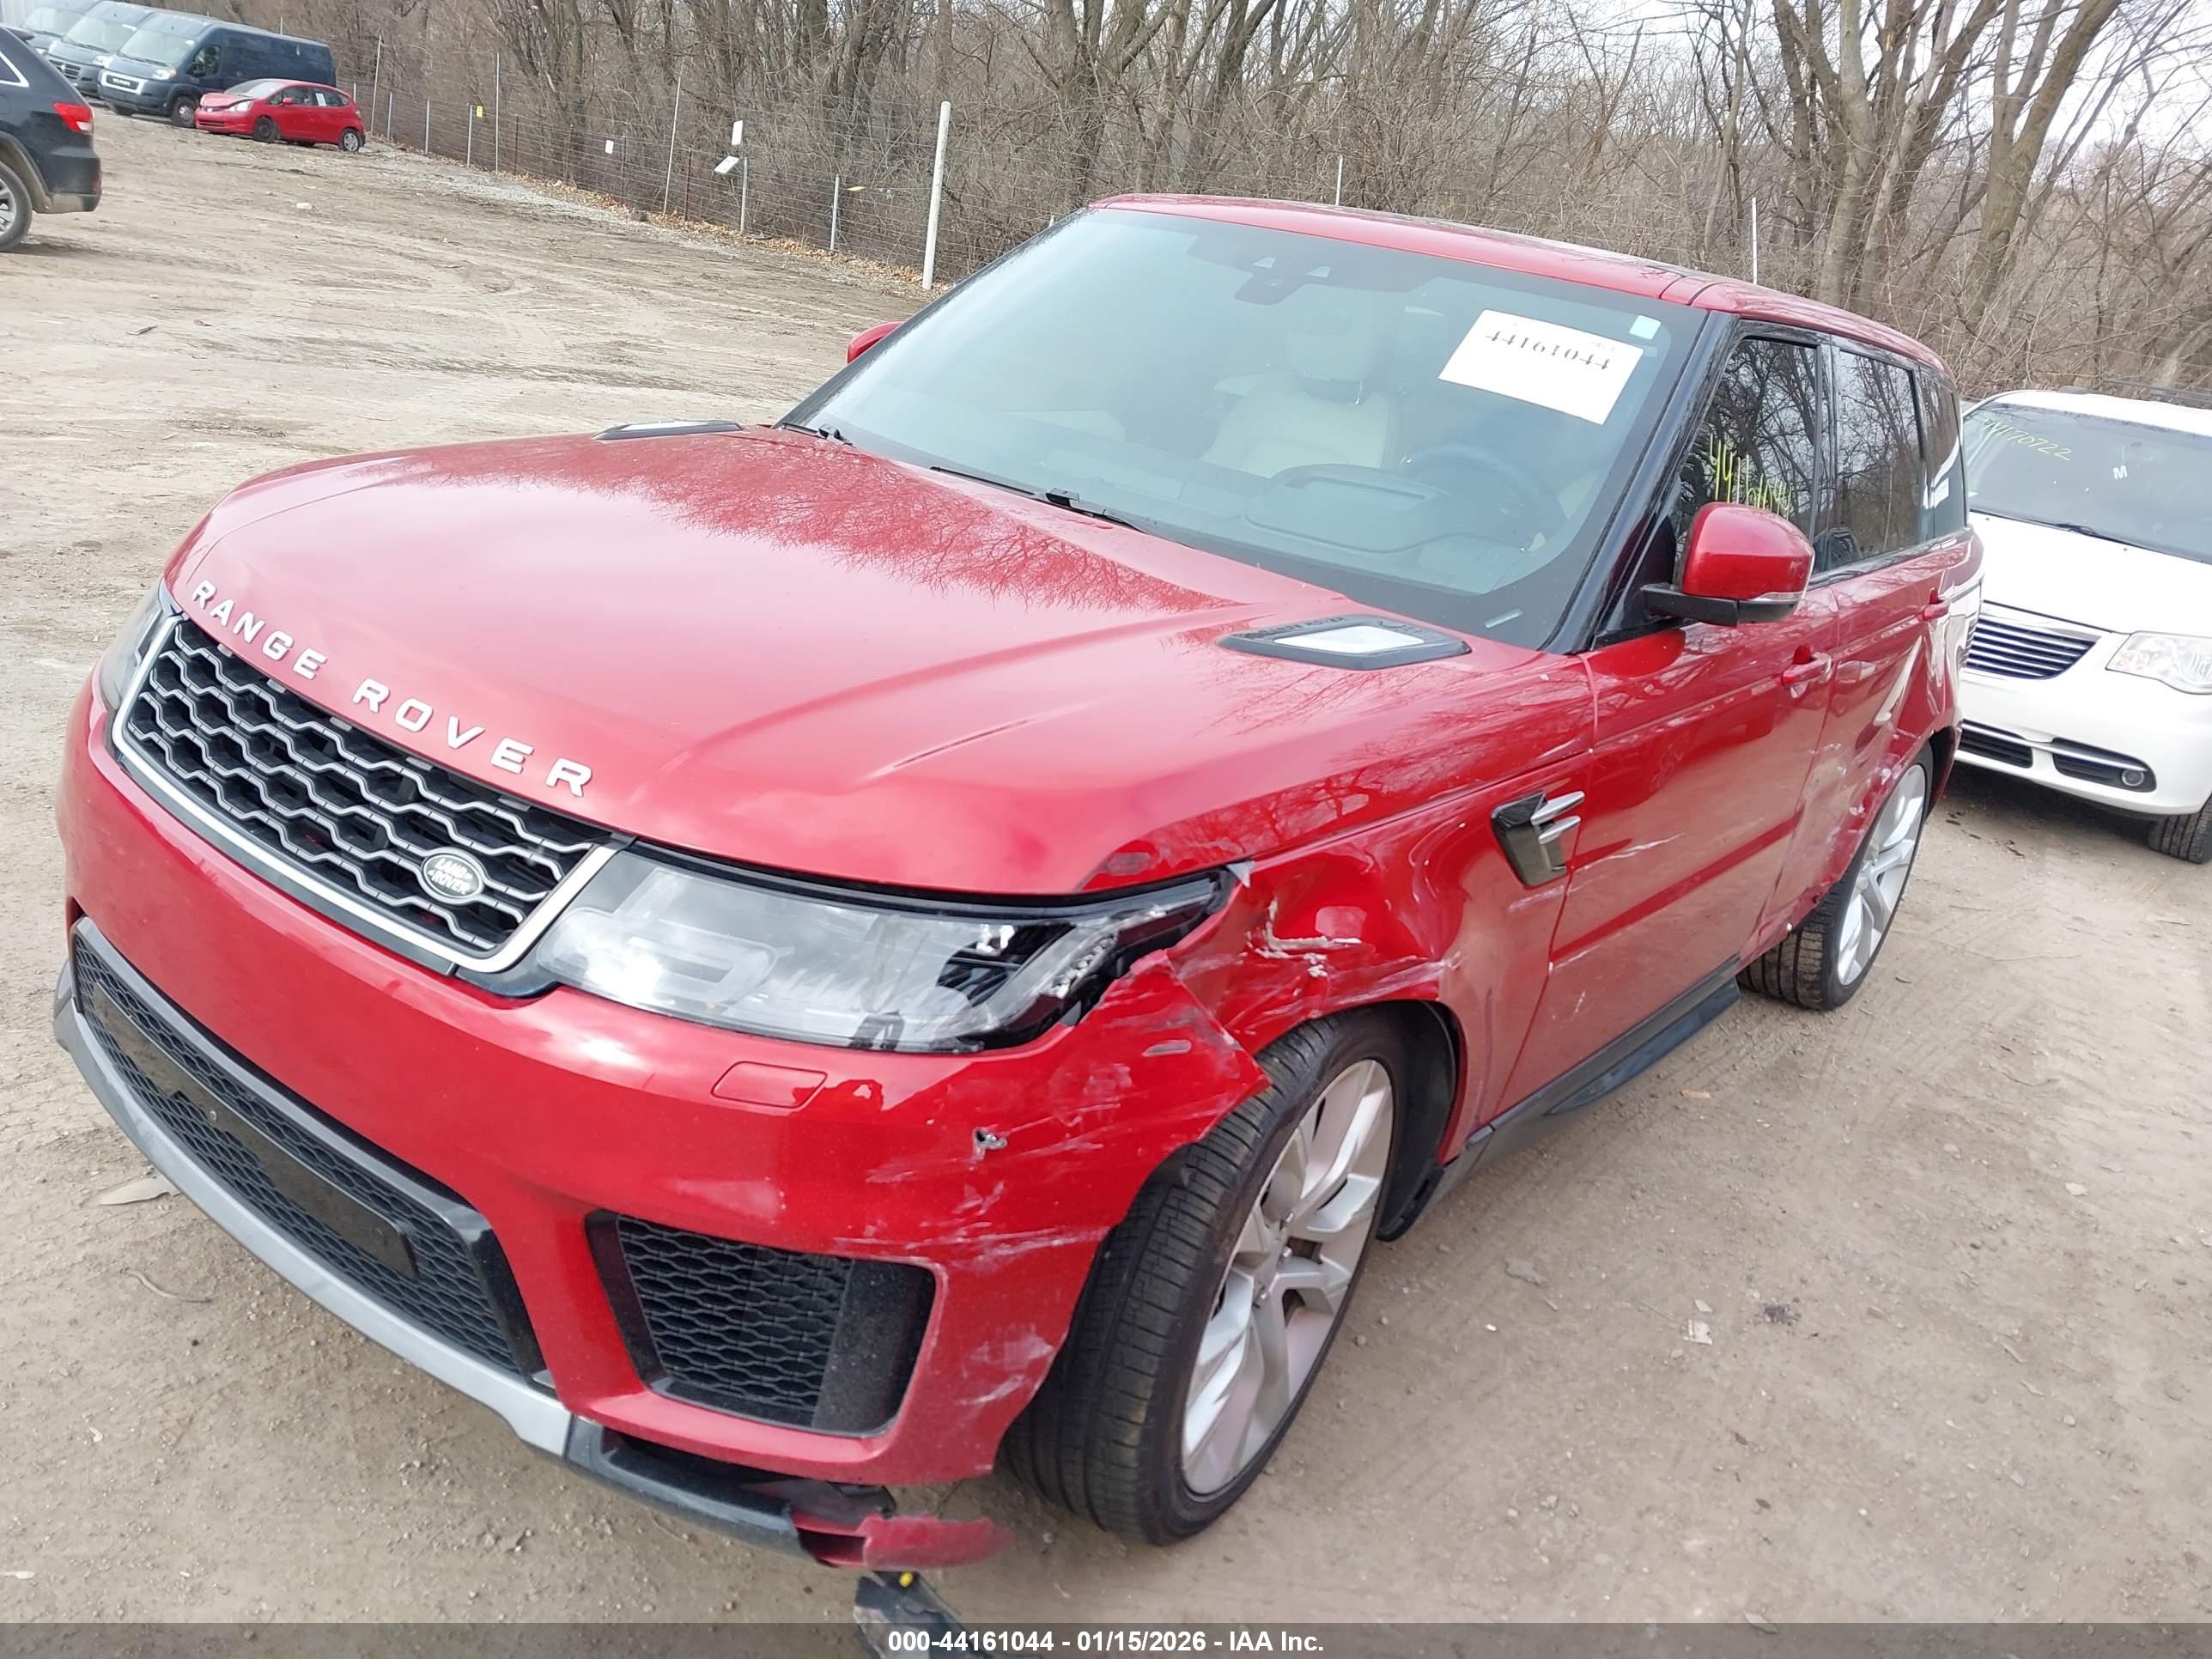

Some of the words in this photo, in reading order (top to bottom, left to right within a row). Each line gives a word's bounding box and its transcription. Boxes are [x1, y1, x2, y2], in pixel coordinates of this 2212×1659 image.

[1486, 331, 1611, 370] 44161044
[192, 580, 328, 680] RANGE
[352, 678, 594, 797] ROVER
[430, 870, 471, 895] ROVER
[434, 857, 468, 878] LAND
